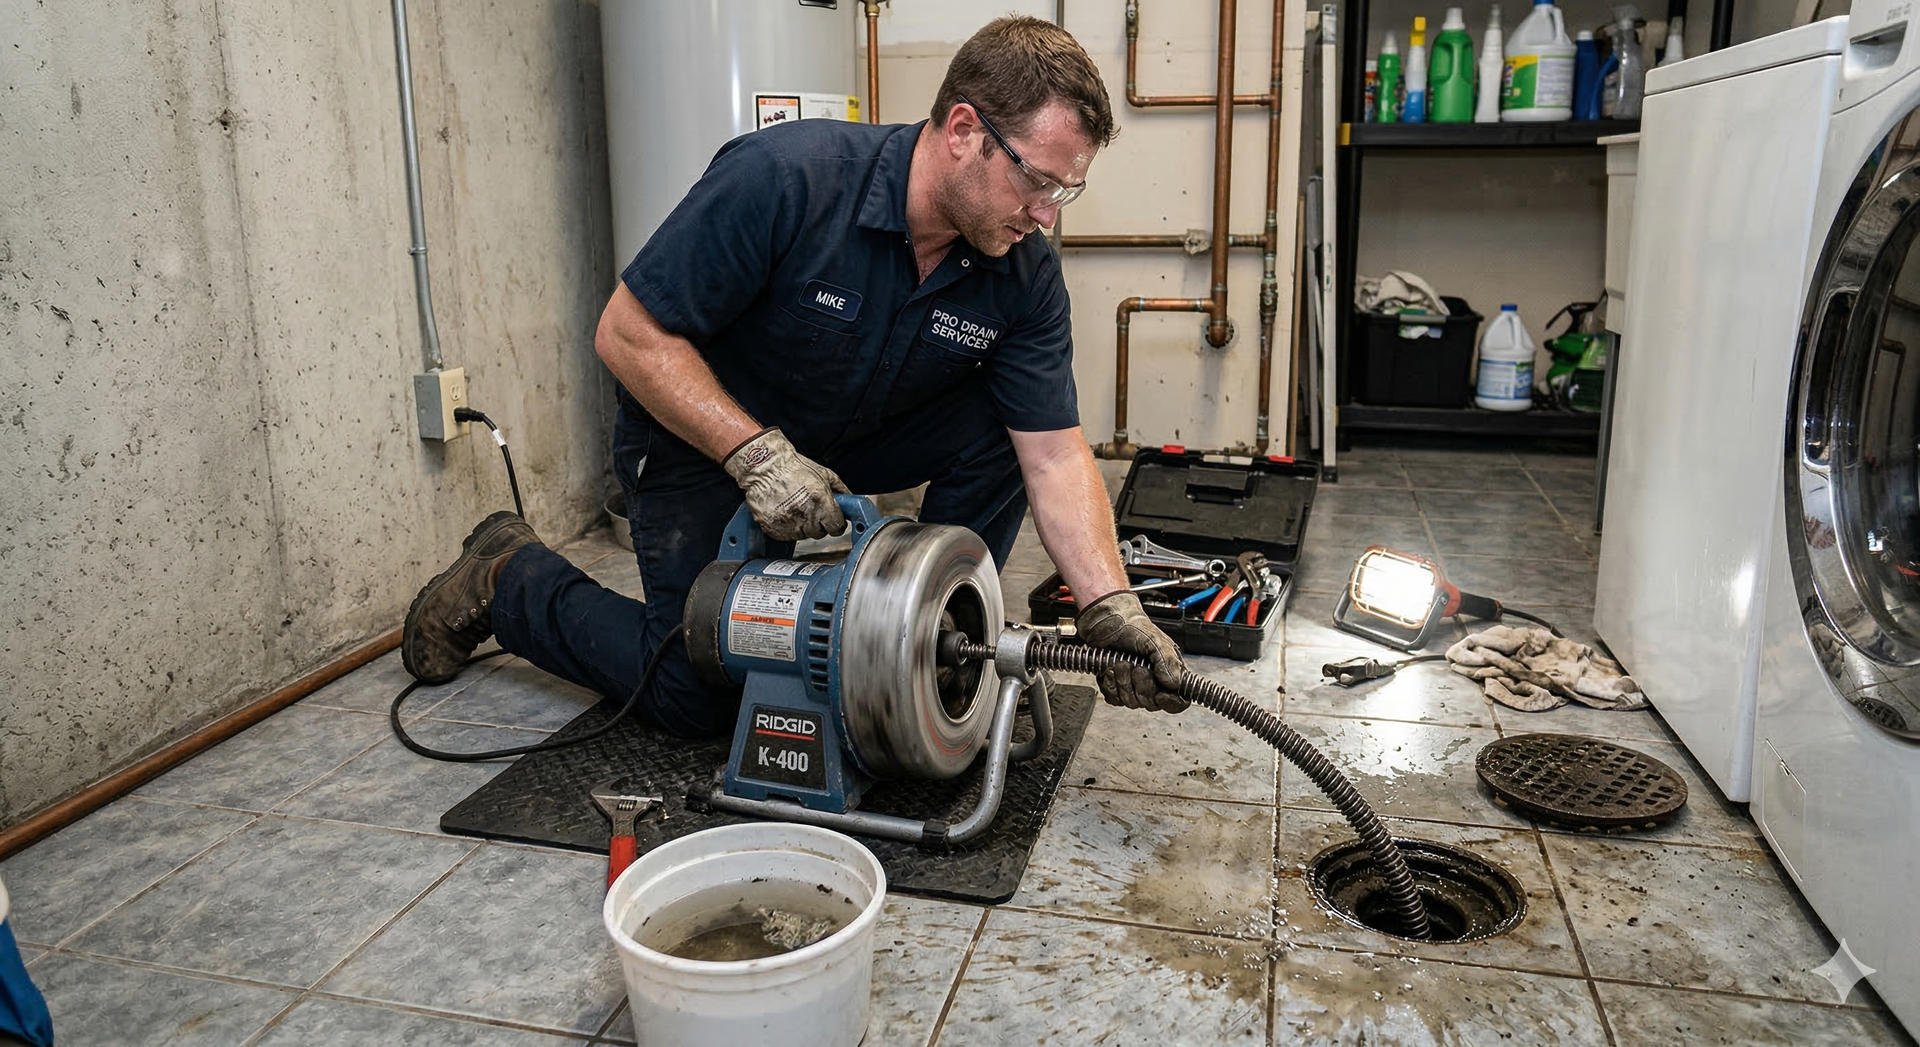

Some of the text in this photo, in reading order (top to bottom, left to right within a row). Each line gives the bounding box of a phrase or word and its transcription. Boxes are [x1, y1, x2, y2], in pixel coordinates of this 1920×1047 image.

[815, 290, 846, 311] MIKE
[931, 309, 998, 341] PRO DRAIN
[931, 323, 990, 350] SERVICES
[755, 713, 816, 735] RIDGID
[757, 746, 809, 773] K-400
